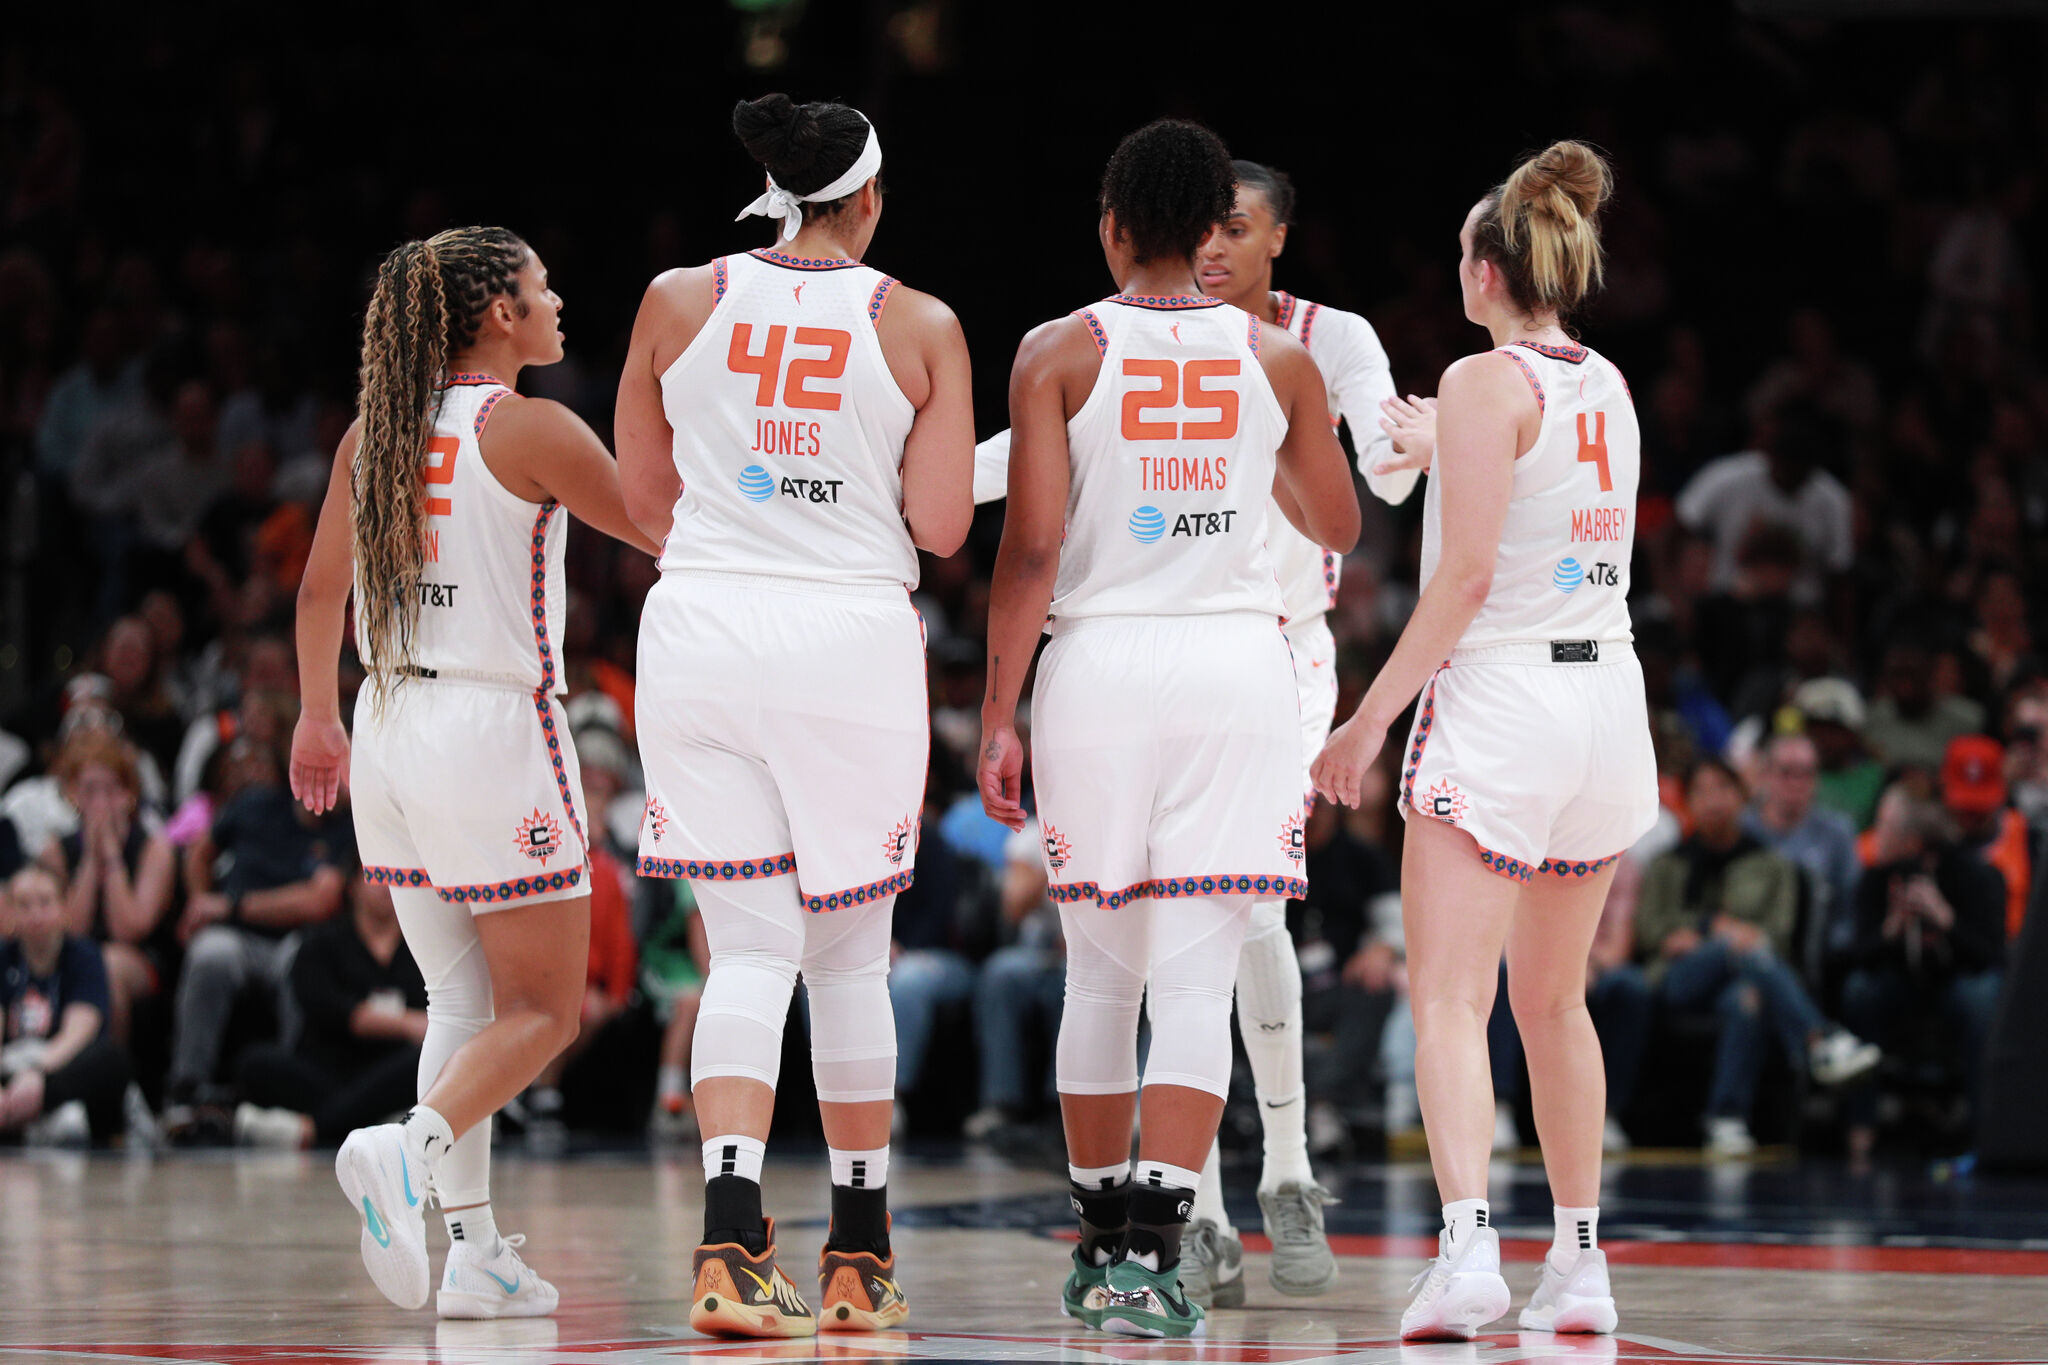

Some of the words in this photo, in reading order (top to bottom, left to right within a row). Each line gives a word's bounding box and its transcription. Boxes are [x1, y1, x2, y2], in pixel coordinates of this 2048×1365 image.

[727, 322, 852, 411] 42
[1120, 358, 1241, 441] 25
[751, 419, 821, 456] JONES
[1576, 411, 1613, 492] 4
[781, 476, 843, 503] AT&T
[1139, 456, 1227, 491] THOMAS
[1171, 510, 1237, 537] AT&T
[1571, 507, 1627, 542] MABREY
[1586, 561, 1619, 586] AT&
[417, 583, 459, 607] T&T
